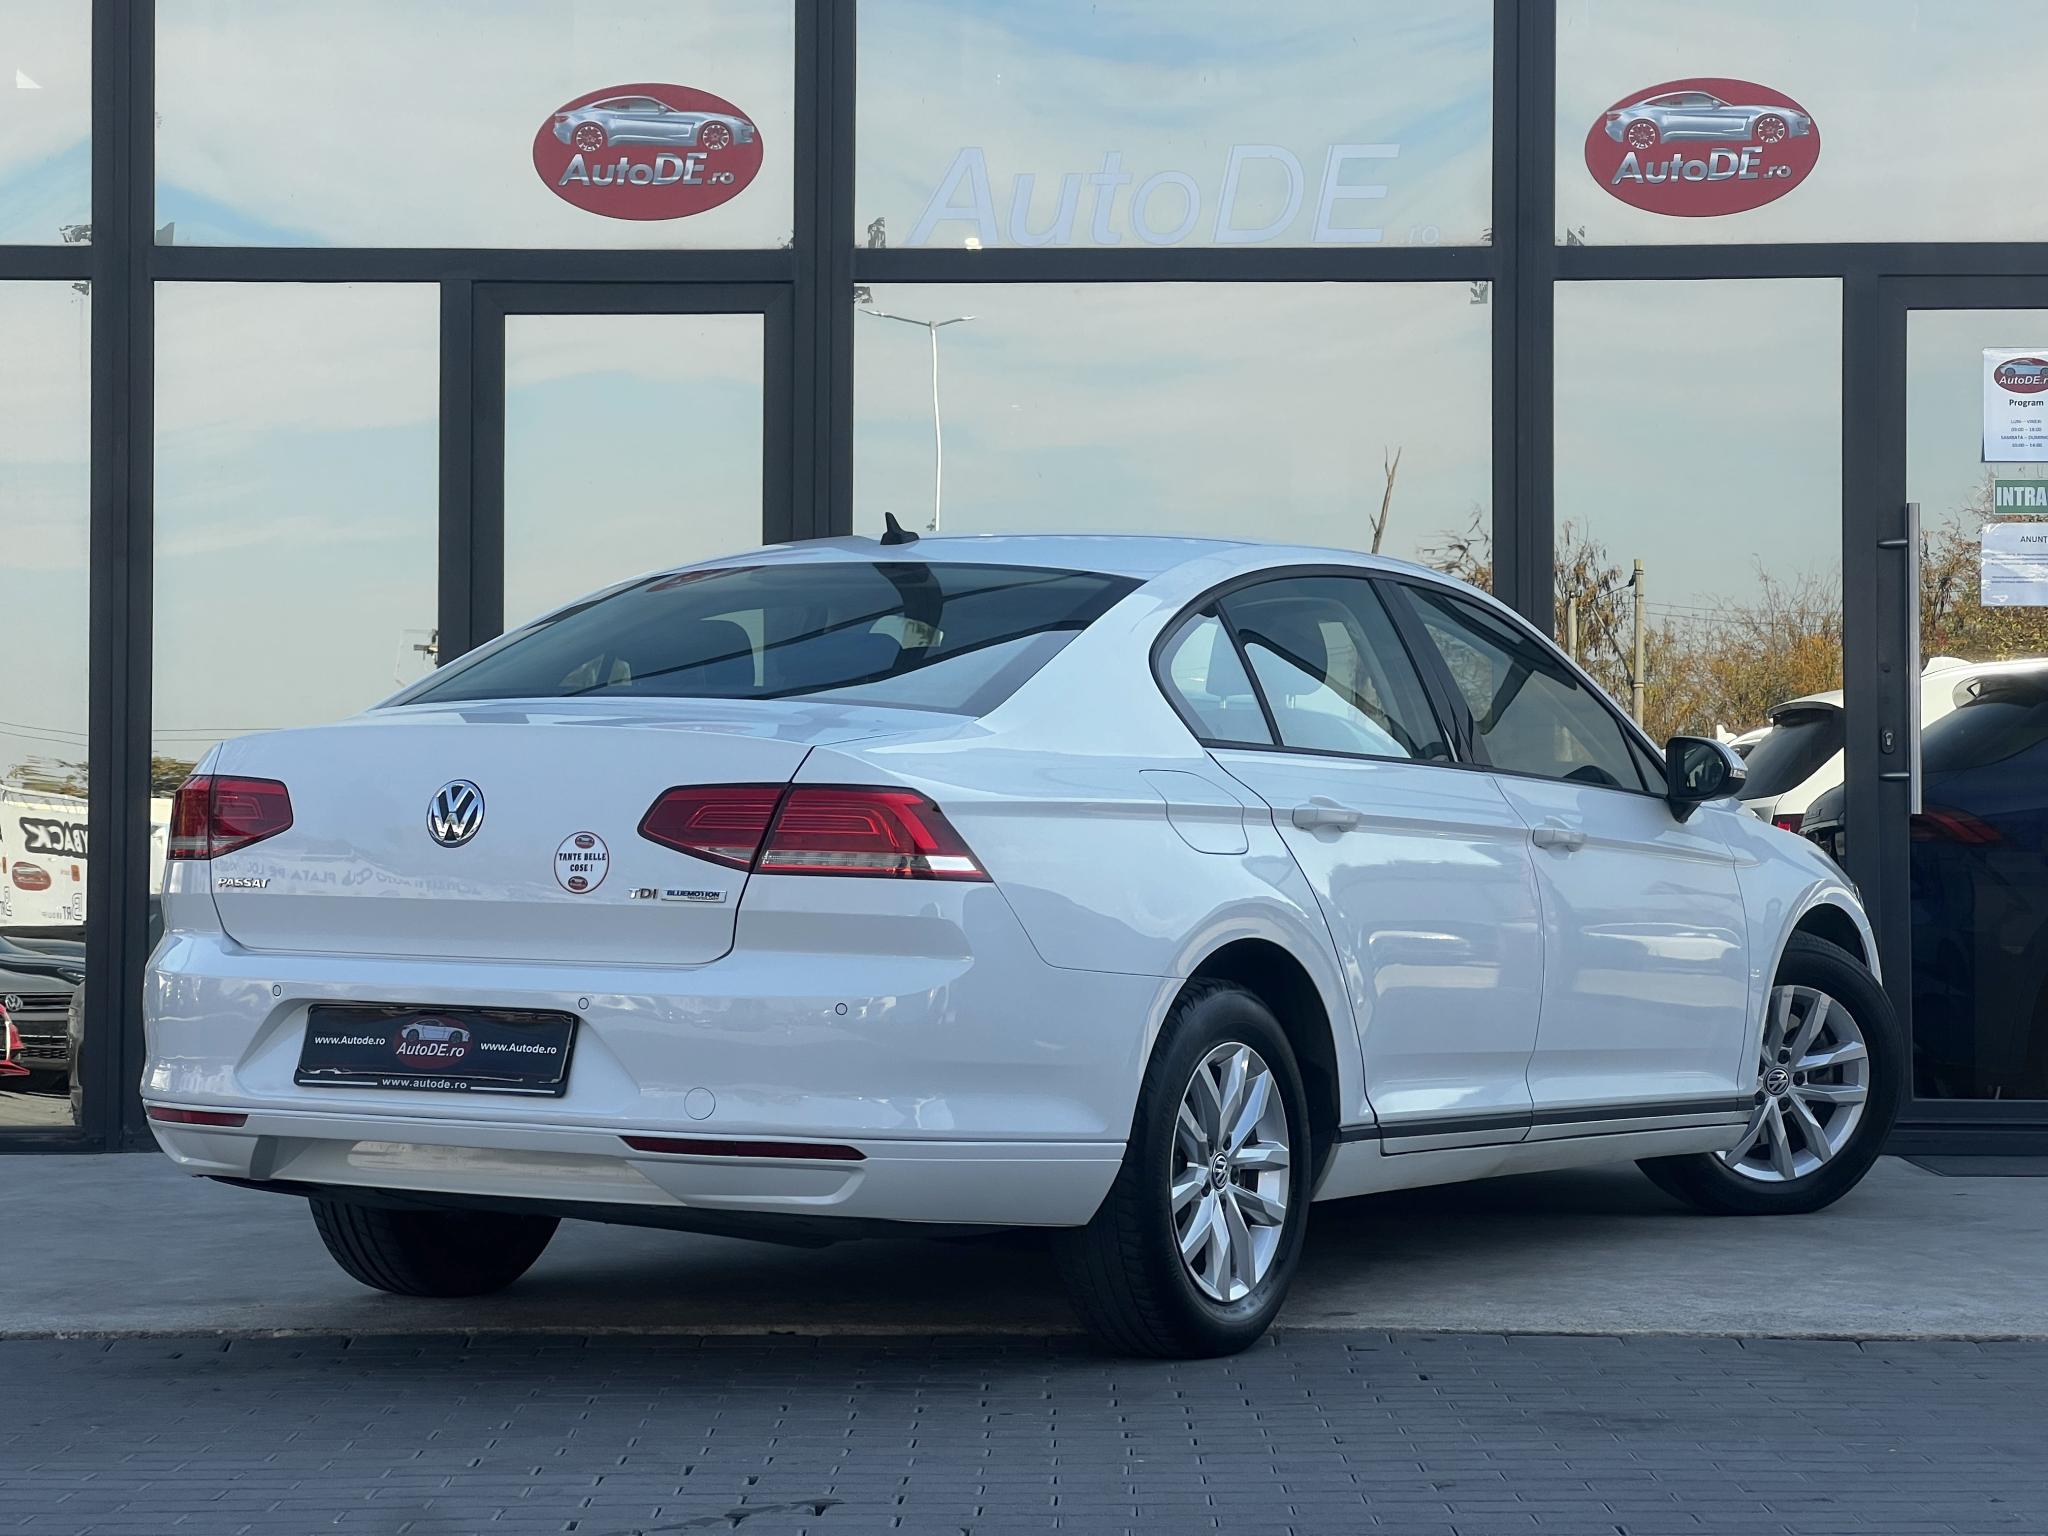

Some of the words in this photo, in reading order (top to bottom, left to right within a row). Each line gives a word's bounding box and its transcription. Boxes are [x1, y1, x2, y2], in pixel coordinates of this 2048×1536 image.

[908, 143, 1401, 248] AutoDE
[2009, 399, 2044, 408] Program
[1996, 486, 2048, 507] INTRA
[559, 852, 582, 861] TANTE
[584, 852, 607, 861] BELLE
[570, 864, 588, 872] COSE
[217, 877, 271, 889] PASSAT
[629, 888, 659, 900] TDI
[314, 1036, 386, 1046] www.Autode.ro
[396, 1042, 465, 1057] AutoDE.ro
[480, 1042, 558, 1055] www.Autode.ro
[382, 1078, 468, 1090] www.autode.ro
